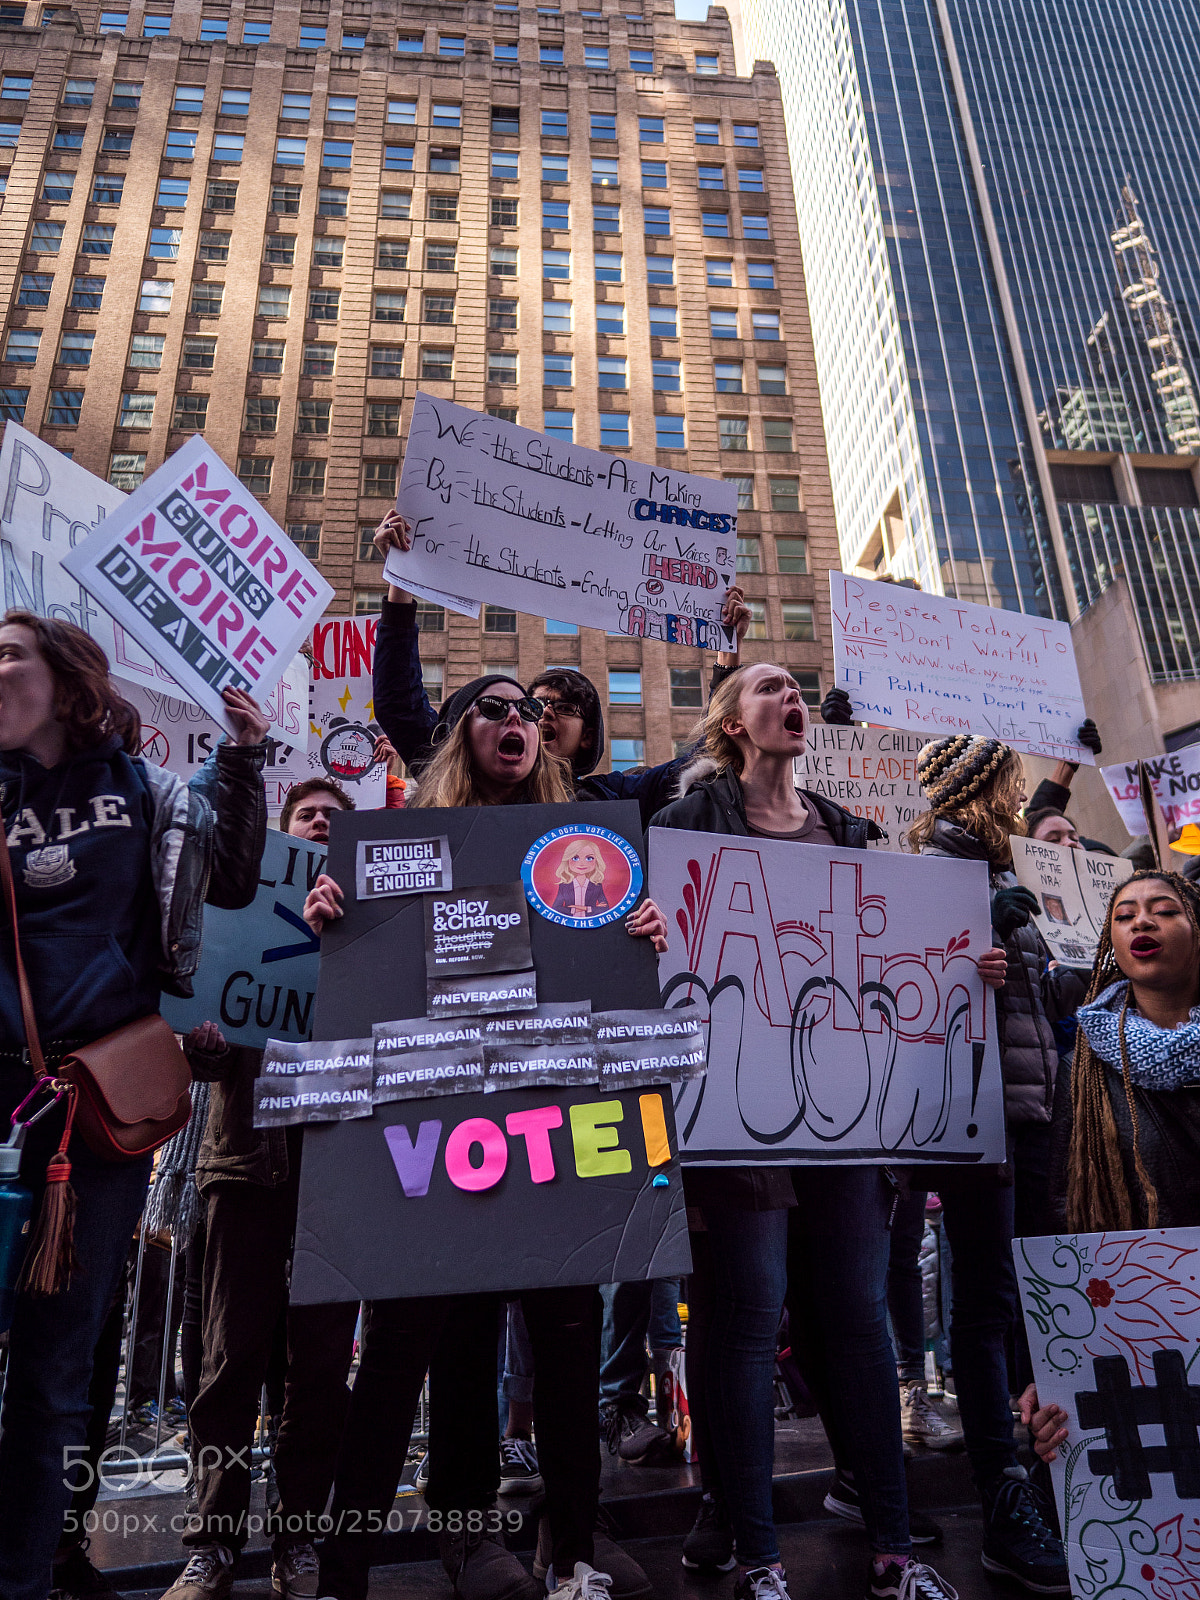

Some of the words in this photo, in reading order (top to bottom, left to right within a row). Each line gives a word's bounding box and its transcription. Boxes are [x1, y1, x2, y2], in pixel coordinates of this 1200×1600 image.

[490, 433, 520, 465] the
[526, 439, 595, 485] Students
[426, 456, 452, 504] By
[471, 478, 500, 505] the
[501, 485, 567, 526] Students
[643, 529, 667, 553] Our
[628, 498, 738, 534] CHANGES!
[180, 461, 318, 619] MORE
[166, 496, 269, 612] GUNS
[411, 516, 445, 555] For
[463, 534, 490, 567] the
[498, 547, 567, 587] Students
[634, 581, 668, 609] Gun
[642, 553, 731, 591] HEARD!
[124, 512, 278, 681] MORE
[103, 549, 251, 694] DEATH
[619, 604, 735, 651] AMERICA!
[832, 609, 884, 635] Vote
[899, 621, 953, 650] Don't
[949, 608, 1028, 648] Today
[845, 644, 865, 660] NY
[983, 692, 1026, 711] Don't
[1038, 703, 1072, 719] Pass
[982, 713, 1031, 740] Vote
[1028, 721, 1082, 748] Them
[793, 755, 836, 777] LIKE
[794, 778, 862, 799] EADERS
[868, 782, 897, 798] ACT
[1113, 778, 1163, 801] LOE
[5, 794, 133, 848] ALE
[1159, 797, 1200, 824] UNS
[372, 843, 434, 862] ENOUGH
[523, 842, 542, 865] DON'T
[540, 836, 550, 850] BE
[558, 825, 583, 836] DOPE.
[585, 824, 606, 837] VOTE
[606, 831, 625, 846] LIKE
[623, 844, 641, 868] KNOPE
[1025, 843, 1060, 862] AFRAID
[397, 863, 411, 872] IS
[1035, 860, 1046, 871] OF
[1085, 857, 1115, 878] NOT
[373, 872, 436, 892] ENOUGH
[432, 899, 489, 917] Policy
[540, 908, 568, 926] FUCK
[573, 919, 595, 928] THE
[598, 910, 621, 924] NRA
[432, 912, 521, 932] &Change
[434, 931, 495, 945] Thoughts
[434, 940, 493, 954] &Prayers
[687, 846, 987, 1045] Action
[219, 970, 316, 1041] GUN
[432, 988, 533, 1005] #NEVERAGAIN
[486, 1016, 588, 1032] #NEVERAGAIN
[597, 1020, 699, 1040] #NEVERAGAIN
[376, 1027, 482, 1051] #NEVERAGAIN
[266, 1055, 370, 1075] #NEVERAGAIN
[489, 1057, 594, 1075] #NEVERAGAIN
[602, 1049, 705, 1075] #NEVERAGAIN
[375, 1062, 482, 1087] #NEVERAGAIN
[258, 1088, 369, 1110] #NEVERAGAIN
[383, 1092, 672, 1198] VOTE!
